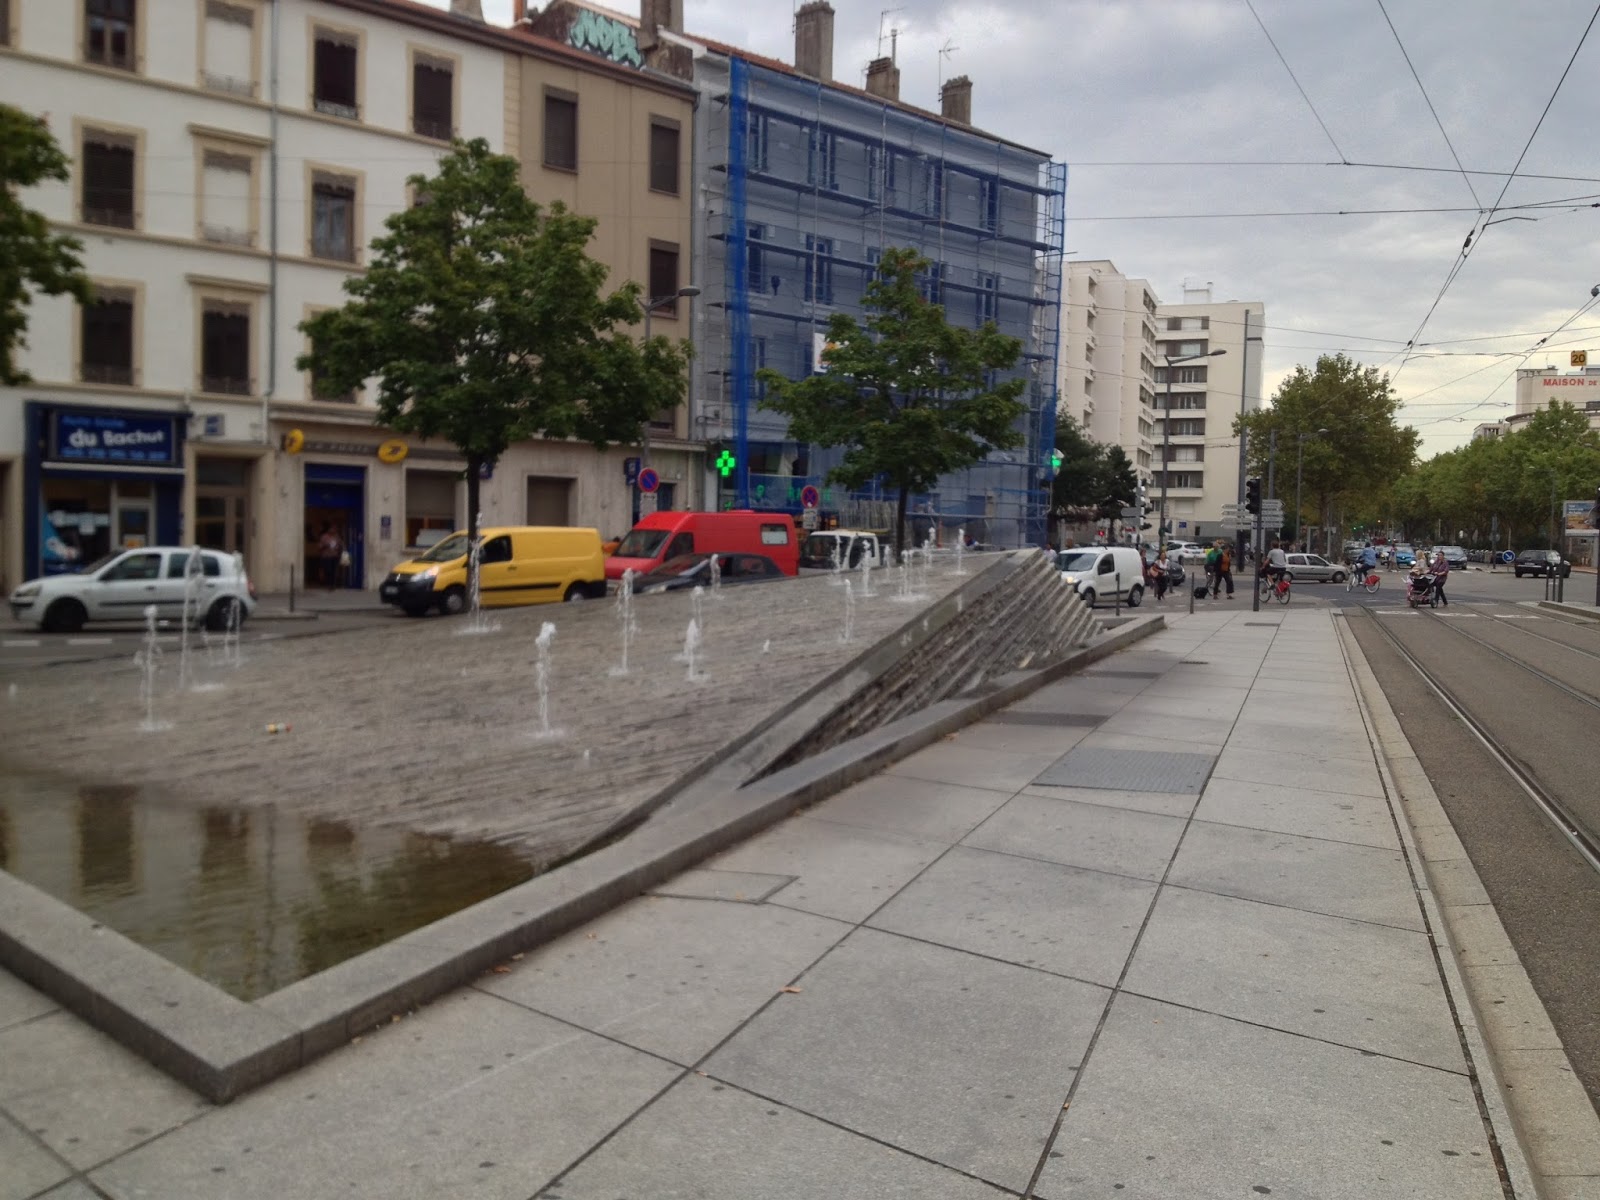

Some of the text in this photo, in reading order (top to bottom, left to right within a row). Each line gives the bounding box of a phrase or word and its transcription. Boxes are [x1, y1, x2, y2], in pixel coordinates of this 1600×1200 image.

[1572, 354, 1586, 363] 20
[68, 428, 165, 448] du Bachut
